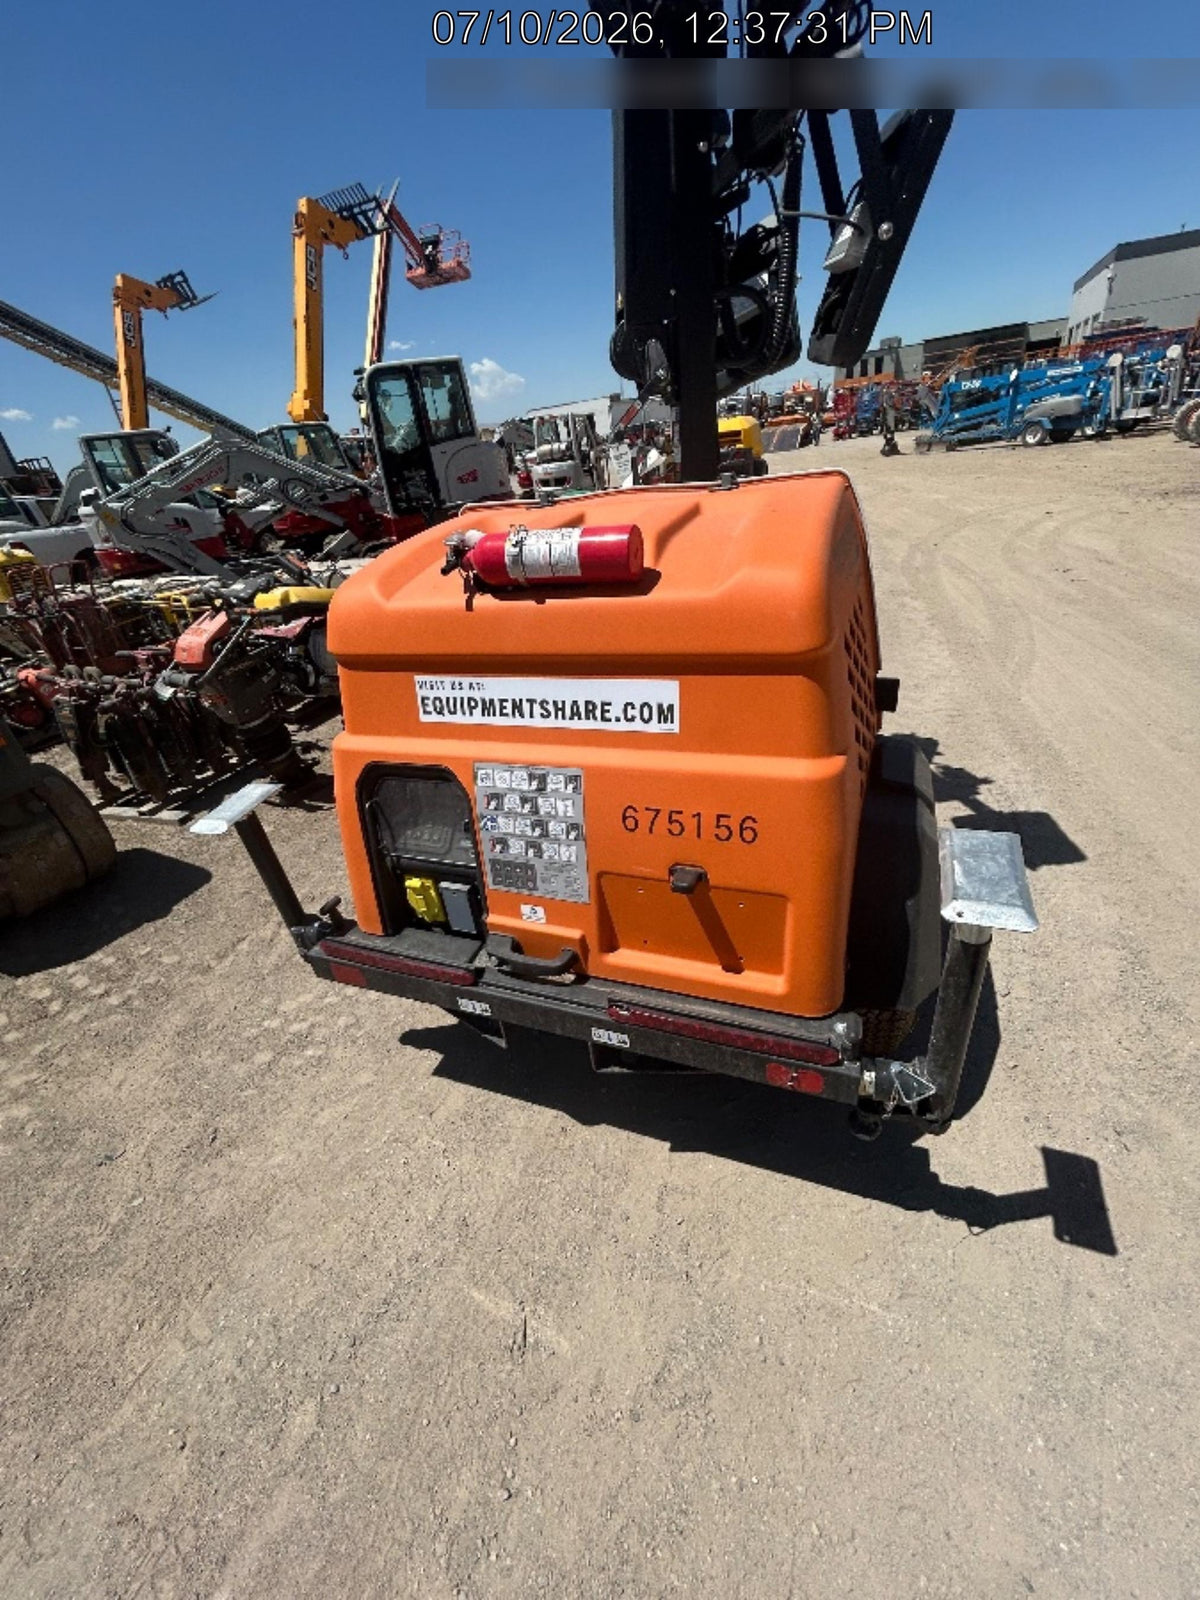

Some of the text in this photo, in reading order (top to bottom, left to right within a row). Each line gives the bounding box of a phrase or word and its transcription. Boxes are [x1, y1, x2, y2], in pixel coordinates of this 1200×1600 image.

[417, 680, 446, 691] VISIT
[450, 680, 464, 691] US
[420, 695, 675, 725] EQUIPMENTSHARE.COM
[621, 804, 759, 845] 675156
